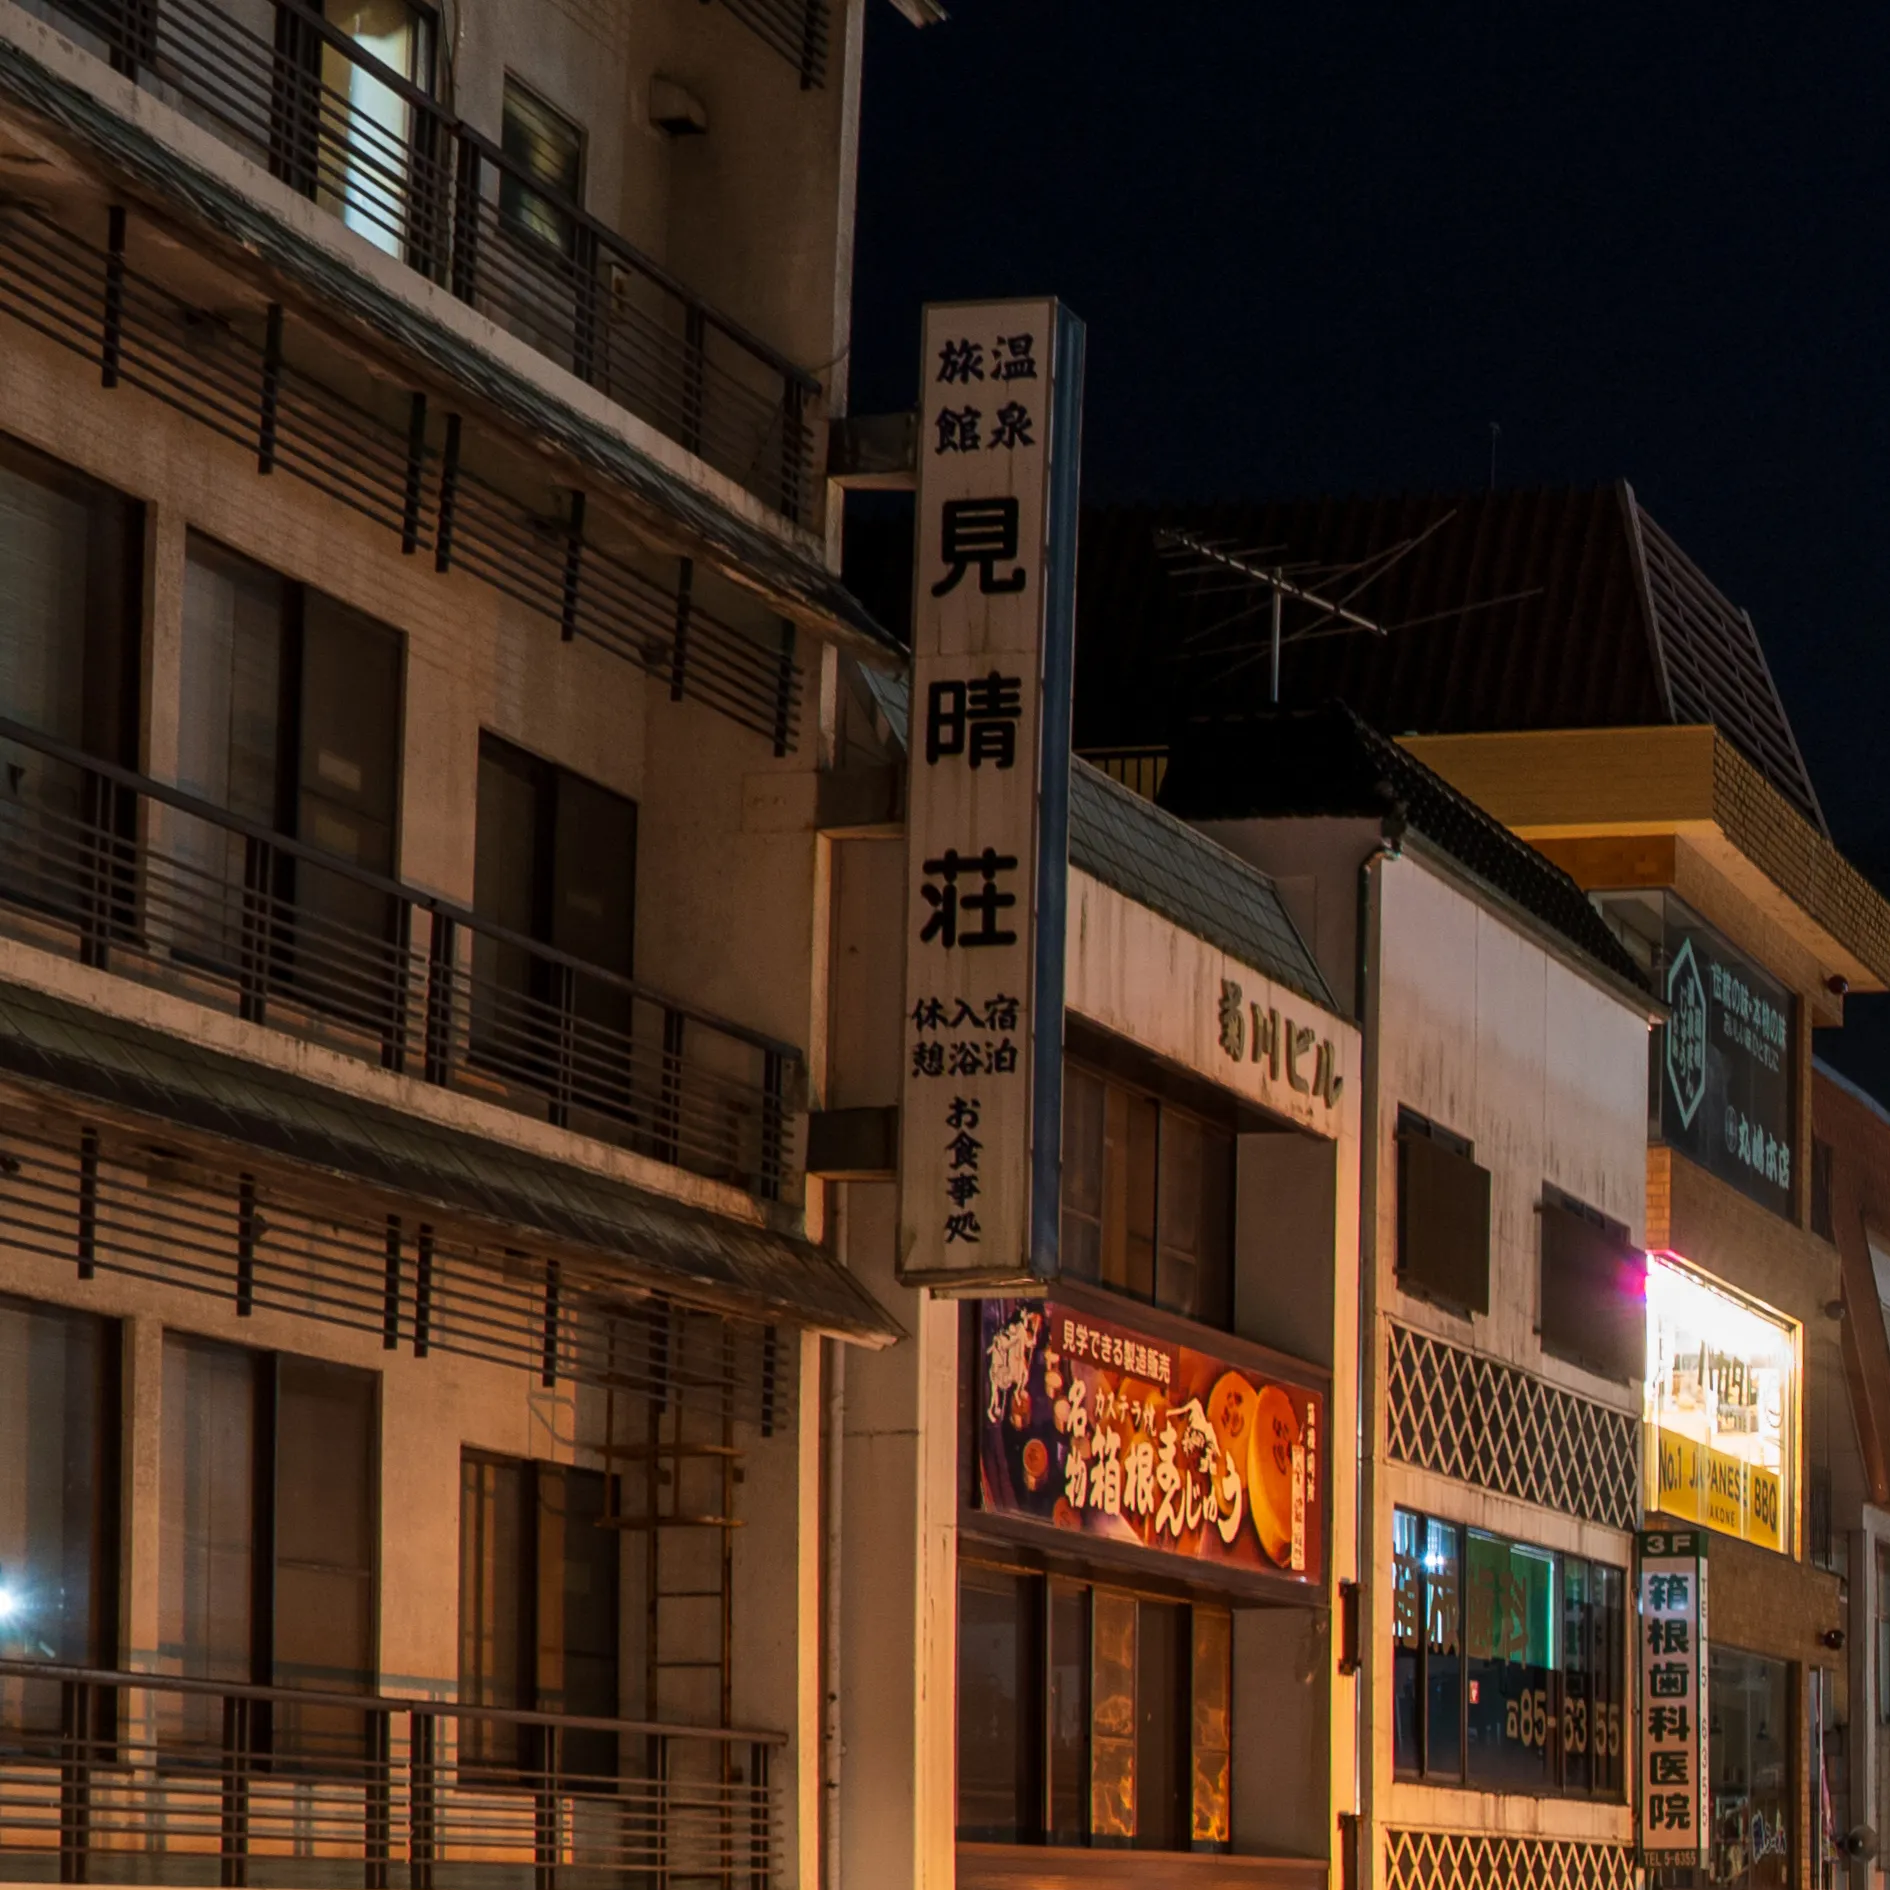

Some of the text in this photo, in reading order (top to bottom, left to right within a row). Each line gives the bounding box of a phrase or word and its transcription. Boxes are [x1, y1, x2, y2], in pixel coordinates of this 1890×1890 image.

[934, 338, 985, 454] 旅館
[990, 334, 1037, 450] 温泉
[920, 497, 1026, 948] 見晴荘
[910, 998, 948, 1078] 休憩
[948, 1001, 985, 1077] 入浴
[984, 994, 1019, 1074] 宿泊
[945, 1097, 983, 1244] お食事処
[1062, 1318, 1172, 1384] 見学できる製造販売
[1064, 1380, 1088, 1508] 名物
[1090, 1418, 1242, 1544] 箱根まんじゅう
[1755, 1477, 1777, 1534] BBQ
[1647, 1574, 1691, 1831] 箱根歯科医院
[1644, 1850, 1661, 1867] TEL
